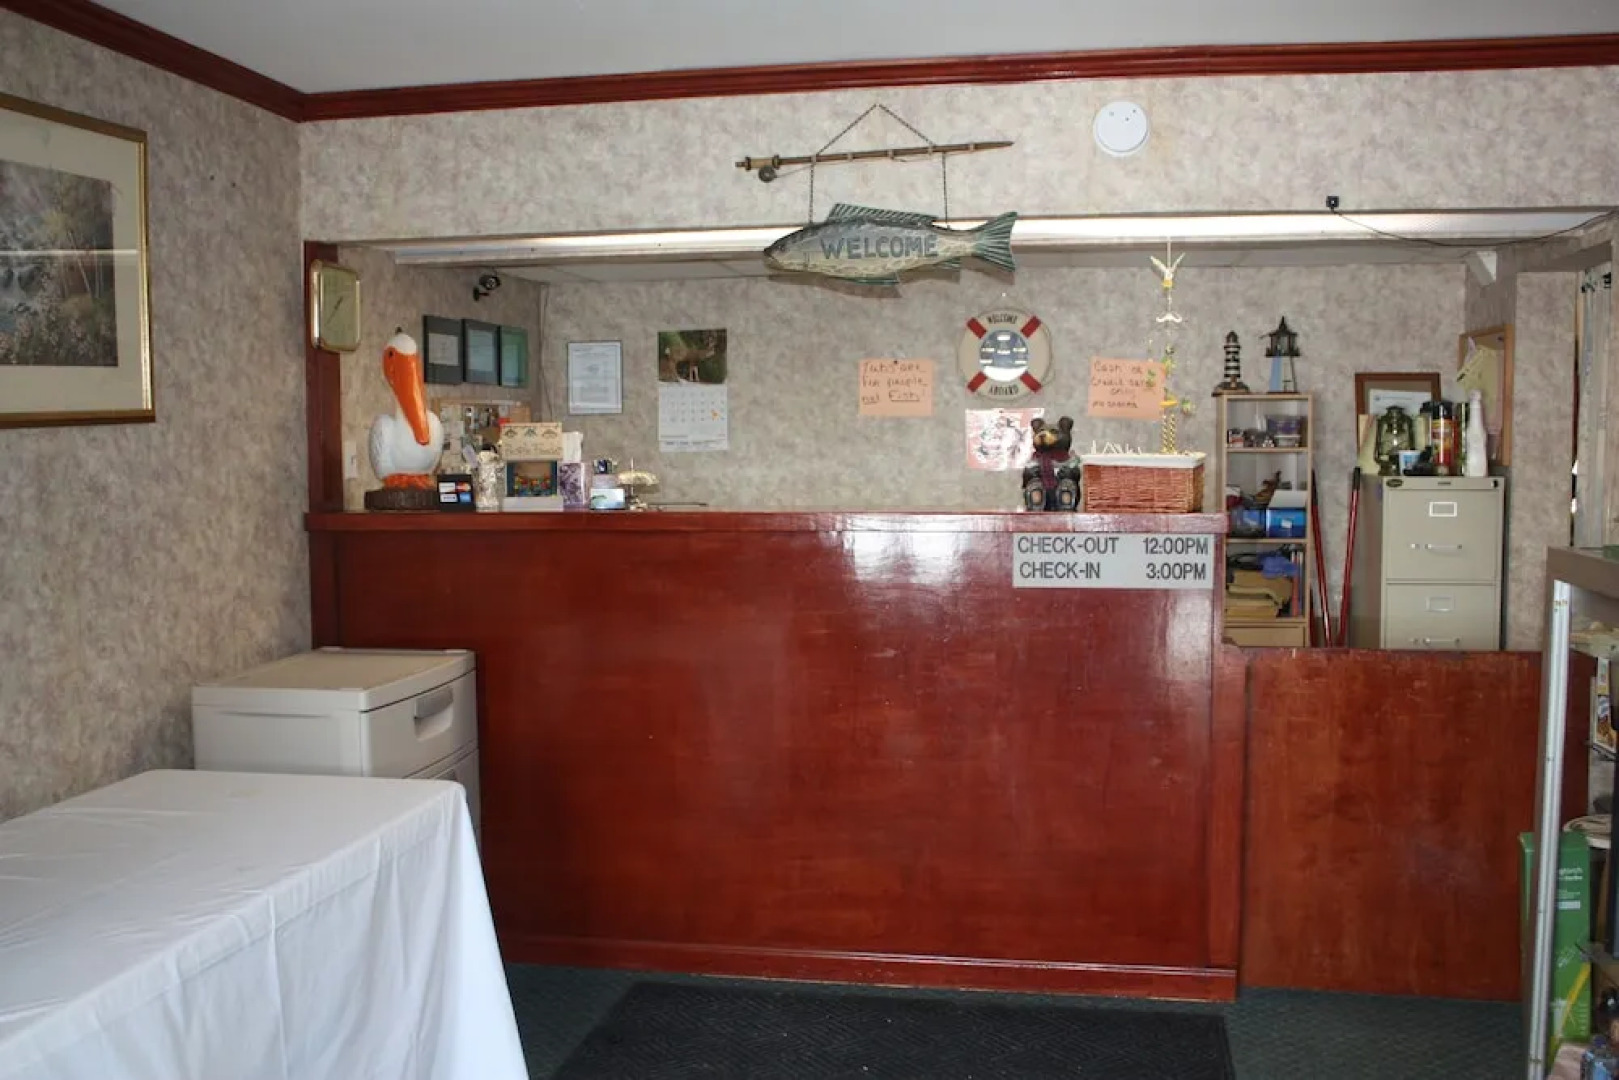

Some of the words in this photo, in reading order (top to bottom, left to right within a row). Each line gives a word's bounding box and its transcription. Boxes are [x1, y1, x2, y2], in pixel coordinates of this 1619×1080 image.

[821, 235, 939, 260] WELCOME
[1017, 536, 1119, 554] CHECK-OUT
[1142, 537, 1209, 555] 12:00PM
[1019, 561, 1101, 579] CHECK-IN
[1146, 562, 1206, 580] 3:00PM
